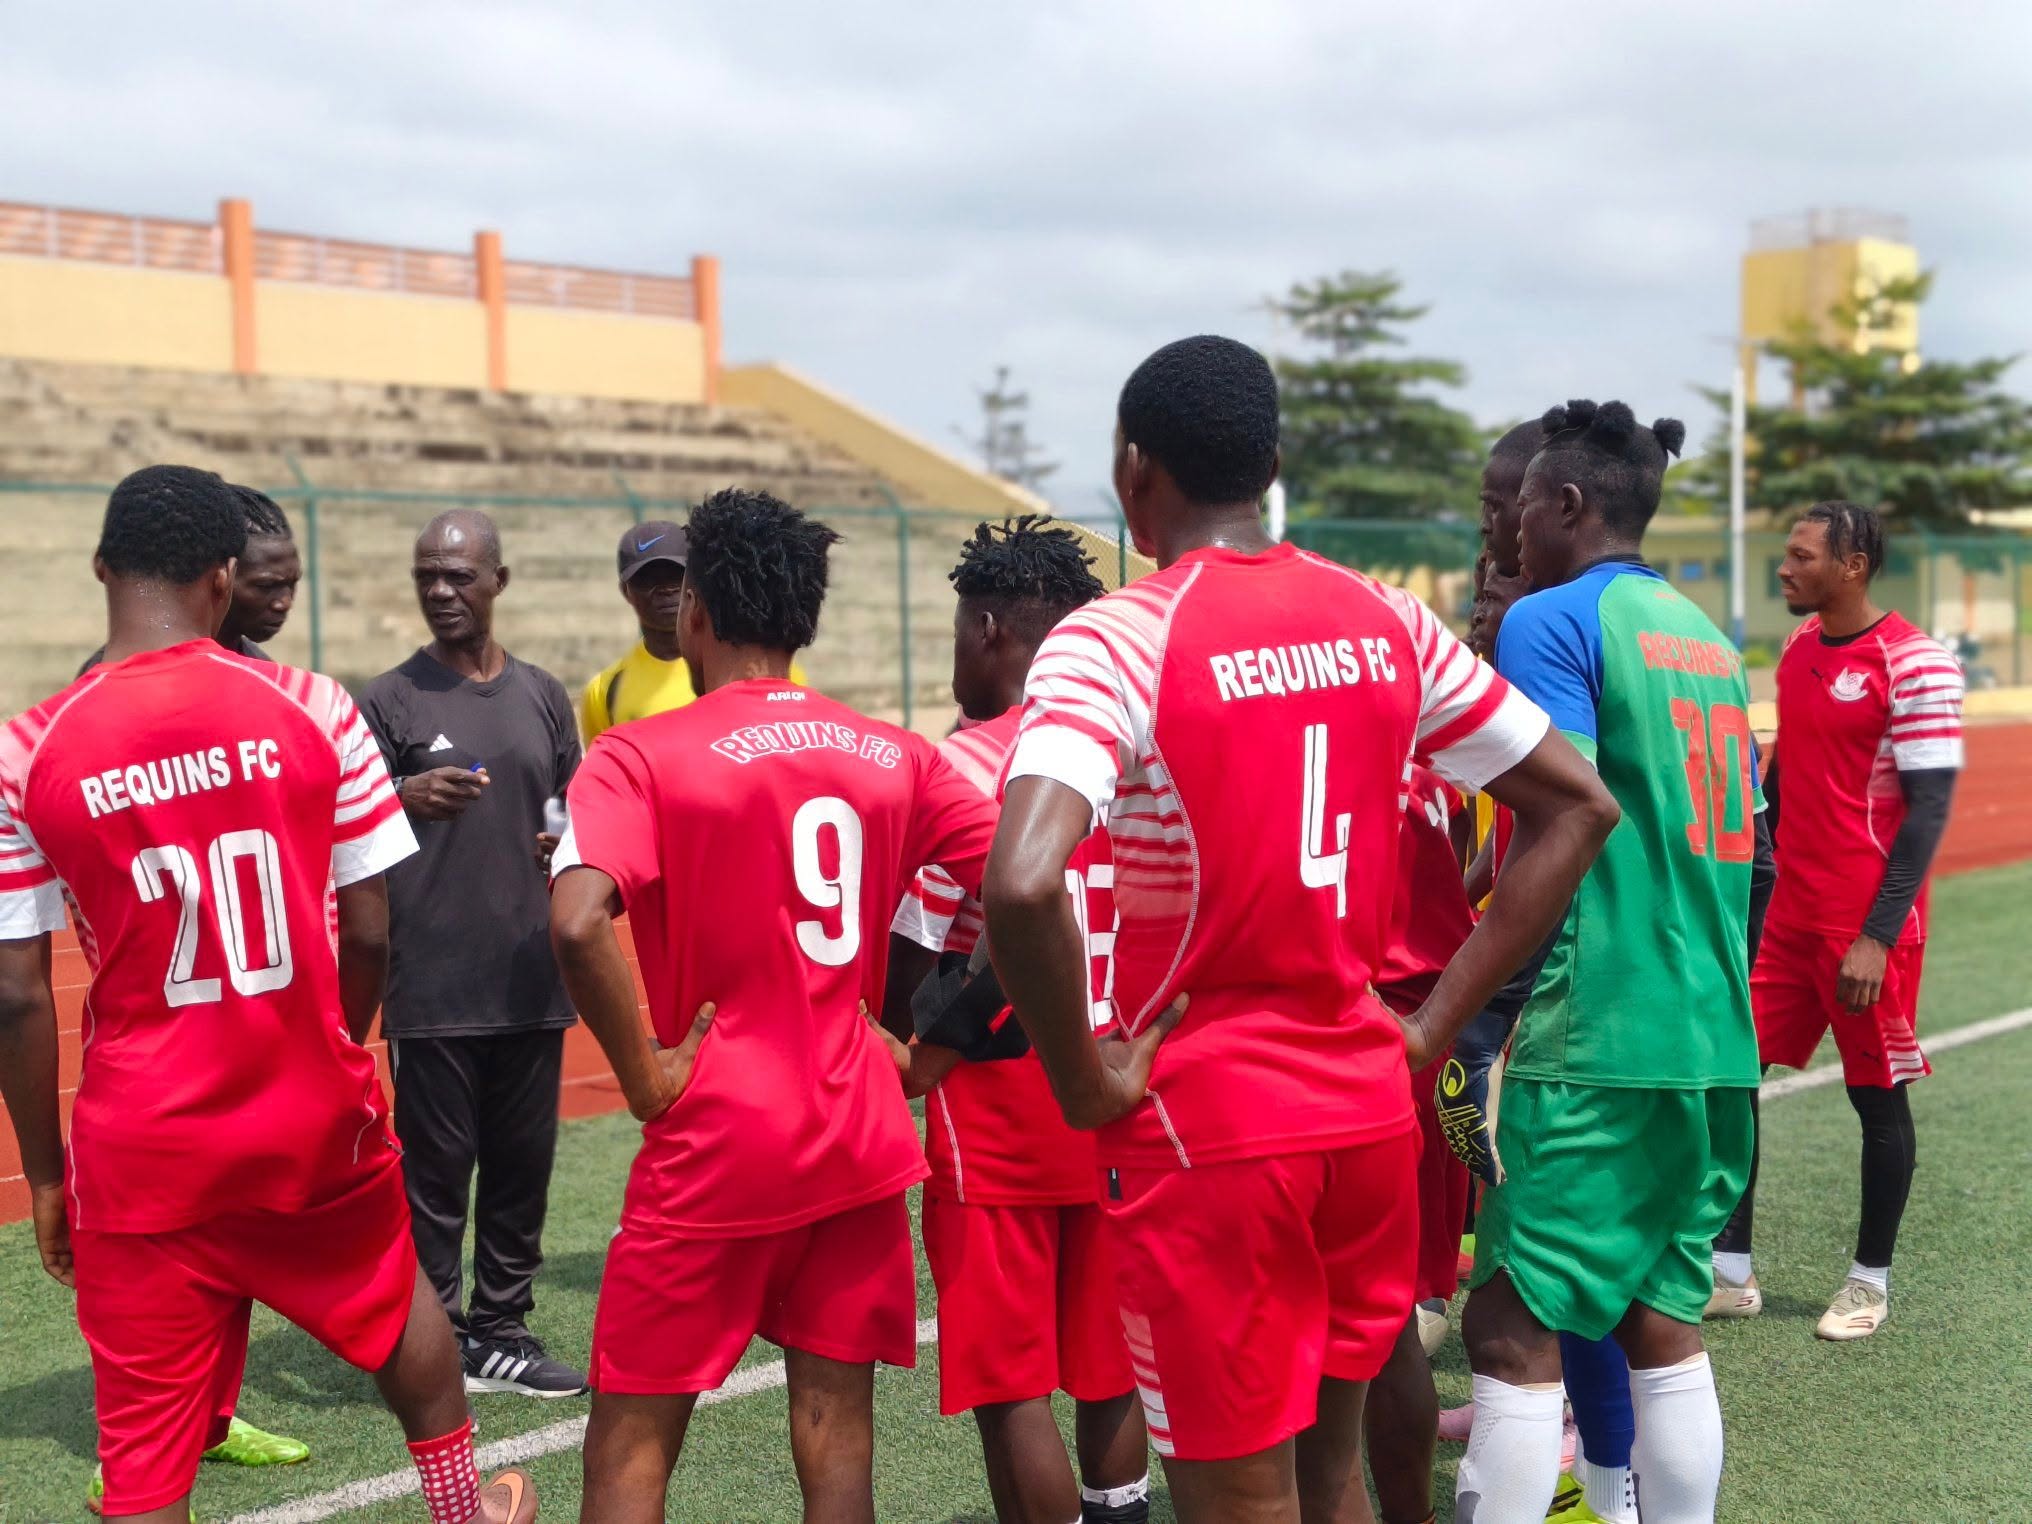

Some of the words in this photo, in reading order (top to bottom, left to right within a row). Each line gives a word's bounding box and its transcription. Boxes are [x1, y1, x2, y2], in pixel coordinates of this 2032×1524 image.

[1209, 639, 1361, 701] REQUINS
[1360, 637, 1396, 682] FC
[79, 746, 231, 819] REQUINS
[238, 738, 281, 781] FC
[710, 721, 857, 764] REQUINS
[859, 734, 901, 769] FC
[792, 796, 863, 966] 9
[1300, 723, 1352, 918] 4
[131, 828, 294, 1007] 20
